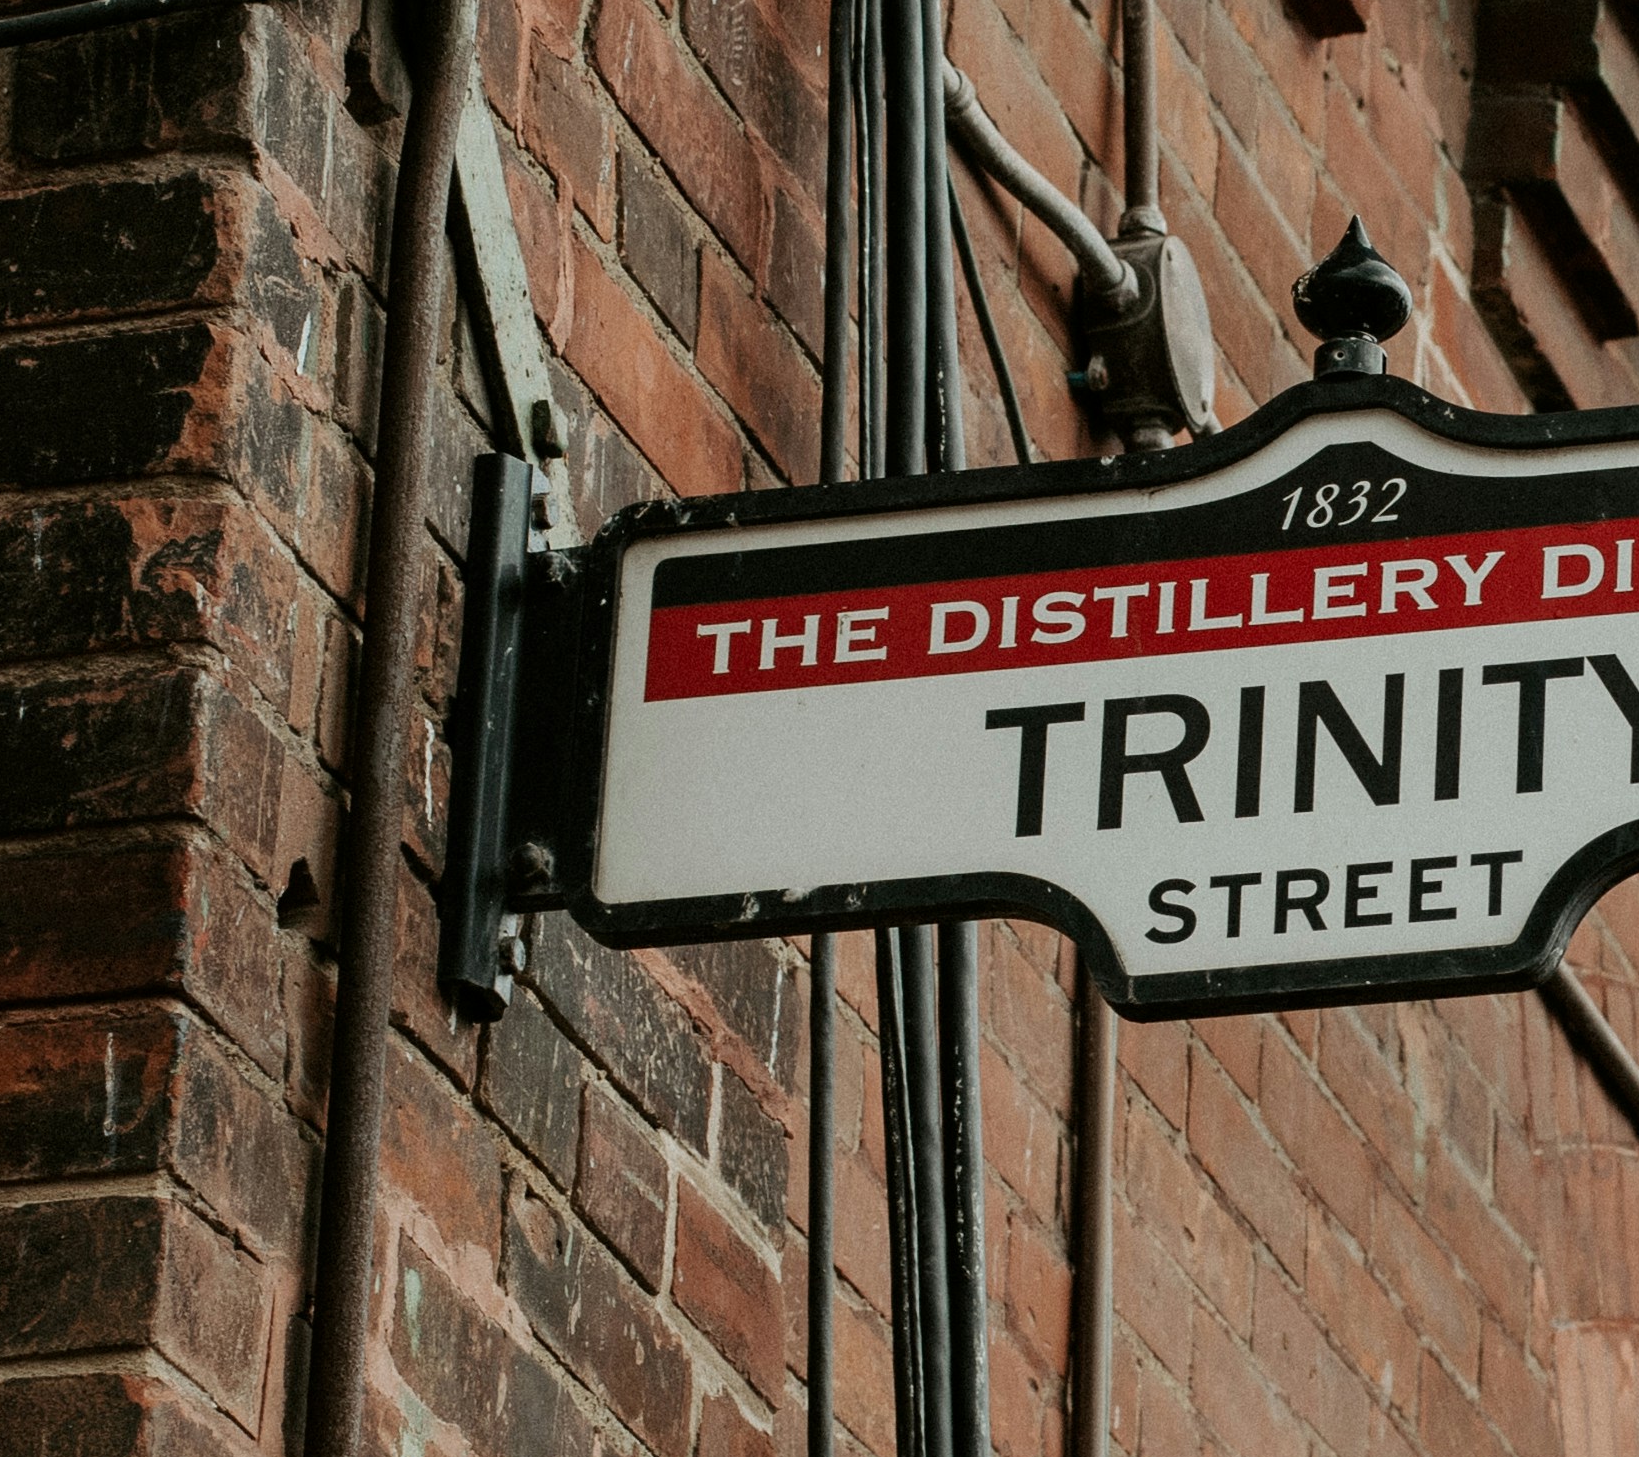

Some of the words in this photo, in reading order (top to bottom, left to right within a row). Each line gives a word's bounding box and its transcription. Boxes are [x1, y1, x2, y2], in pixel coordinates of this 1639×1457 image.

[1277, 477, 1409, 532] 1832
[696, 606, 891, 677] THE
[927, 550, 1505, 657] DISTILLERY
[1146, 850, 1523, 945] STREET
